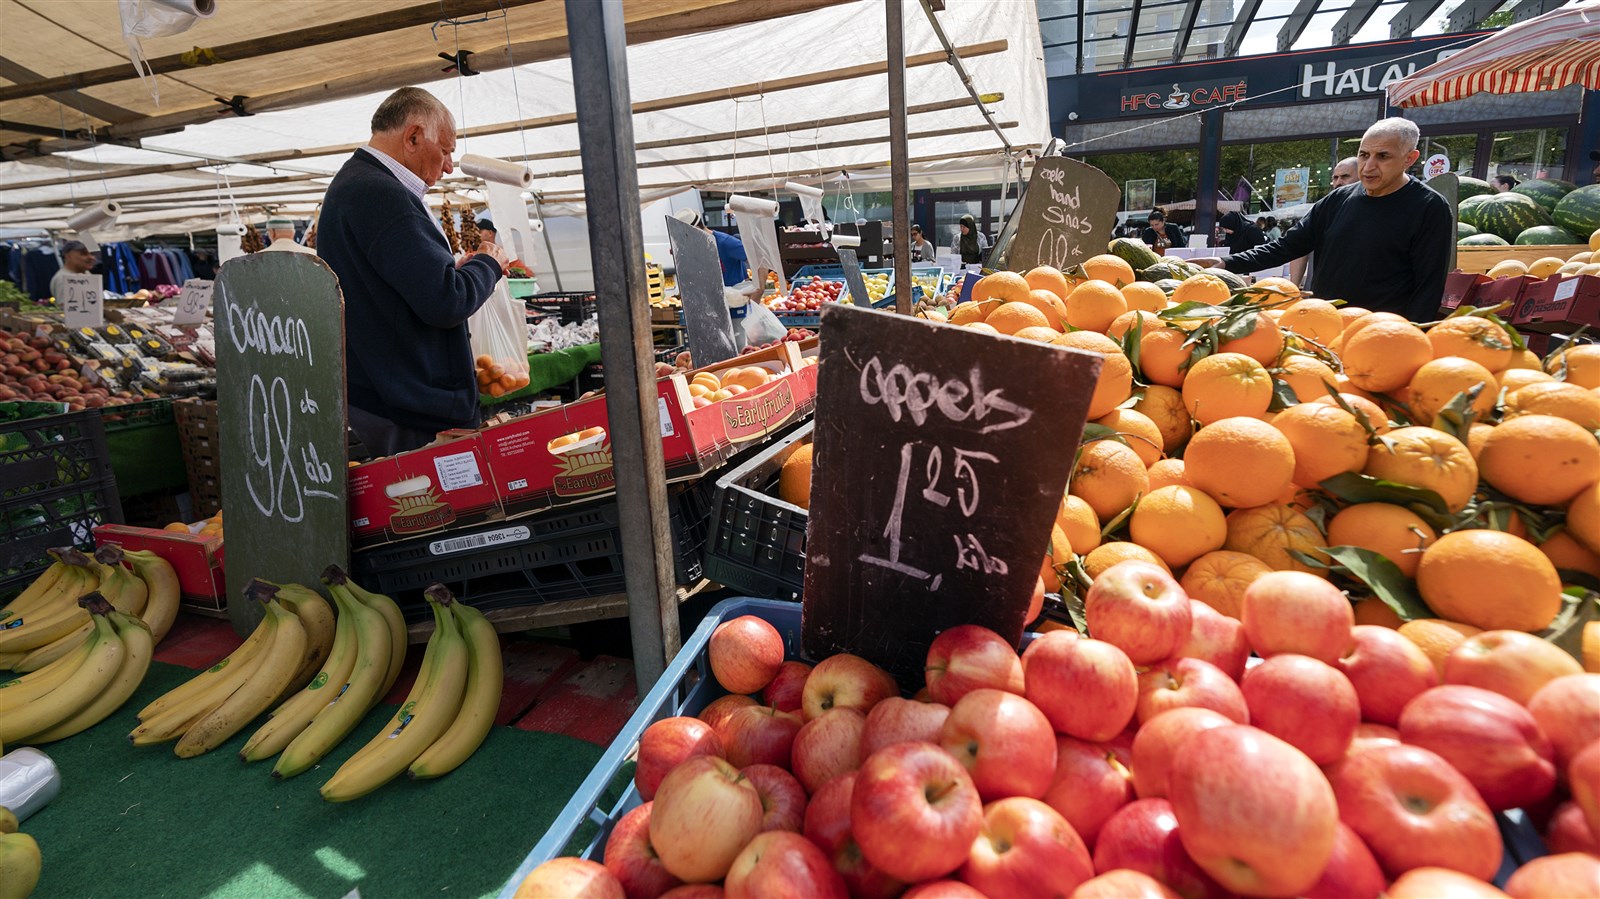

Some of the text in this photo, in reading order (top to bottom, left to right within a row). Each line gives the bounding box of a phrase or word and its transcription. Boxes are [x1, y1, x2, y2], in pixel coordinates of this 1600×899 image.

[1121, 80, 1248, 112] HFC CAFÉ
[1050, 184, 1080, 209] hand
[183, 290, 200, 315] 98
[221, 280, 313, 367] banaan
[735, 391, 786, 428] Earlyfruit
[246, 374, 304, 523] 98
[566, 471, 616, 490] Earlyfru
[487, 532, 506, 543] 13604
